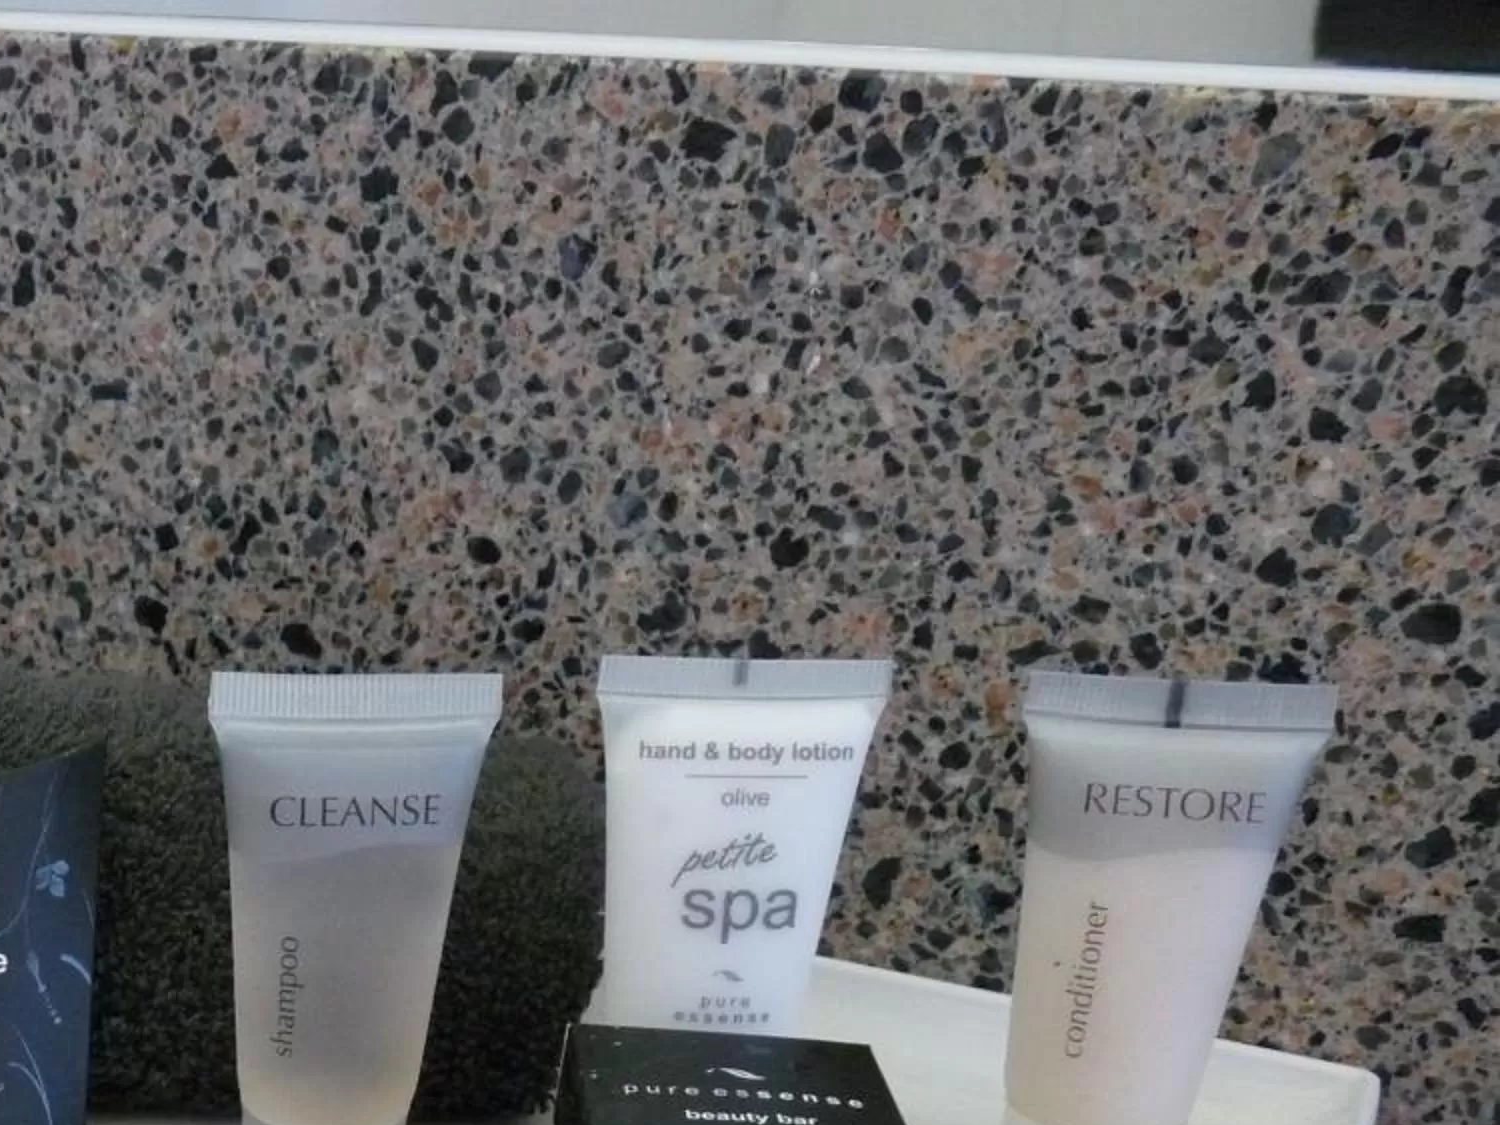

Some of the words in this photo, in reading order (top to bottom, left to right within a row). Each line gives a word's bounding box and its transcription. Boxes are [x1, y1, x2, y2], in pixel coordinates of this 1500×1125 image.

[639, 740, 696, 760] hand
[704, 742, 720, 760] &
[728, 741, 785, 766] body
[792, 742, 853, 761] lotion
[269, 793, 442, 828] CLEANSE
[720, 787, 770, 807] olive
[1083, 782, 1267, 825] RESTORE
[671, 832, 778, 888] petite
[681, 888, 797, 944] spa
[269, 935, 305, 1058] shampoo
[1063, 902, 1109, 1060] conditioner
[699, 995, 751, 1010] pure
[673, 1011, 770, 1026] essense
[623, 1082, 699, 1097] pure
[713, 1087, 864, 1110] essense
[684, 1108, 769, 1125] beauty
